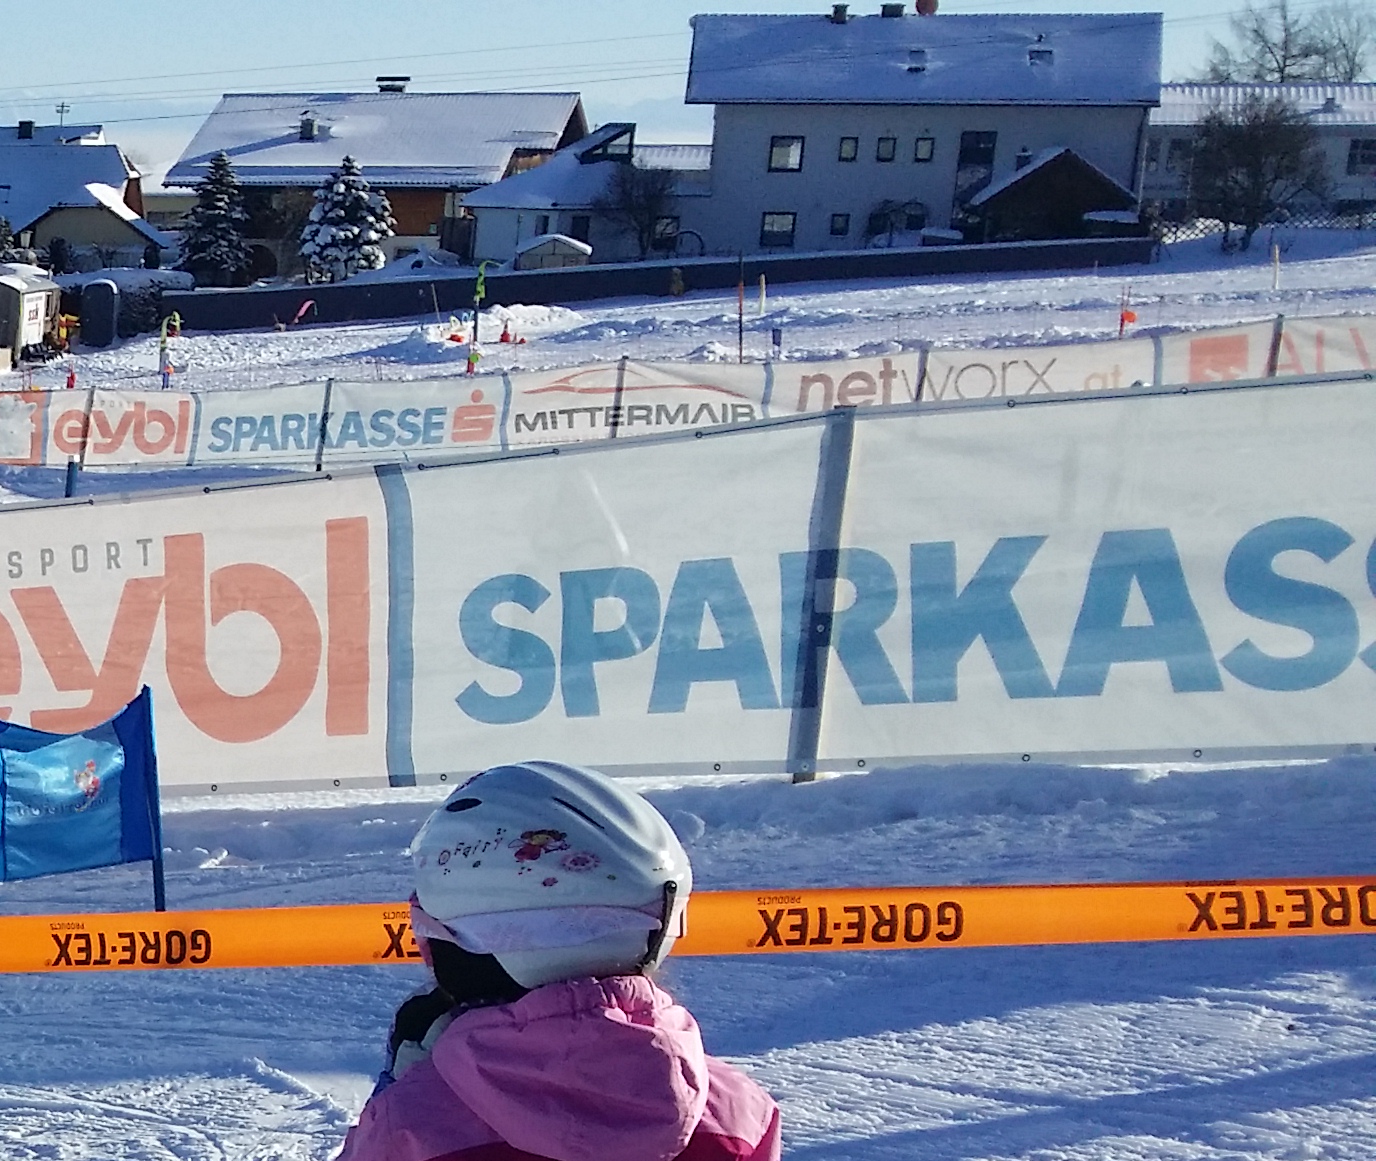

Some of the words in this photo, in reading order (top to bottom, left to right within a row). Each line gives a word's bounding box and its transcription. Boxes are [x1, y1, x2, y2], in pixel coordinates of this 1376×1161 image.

[53, 400, 191, 455] eybl
[208, 406, 447, 453] SPARKASSE
[514, 403, 756, 433] MITTERMAIR
[7, 538, 153, 579] SPORT
[454, 516, 1376, 725] SPARKAS
[757, 895, 801, 905] PRODUCTS
[1185, 885, 1376, 932] ORE-TEX
[49, 922, 86, 930] PRODUCTS
[756, 901, 965, 947] GORE-TEX
[52, 929, 213, 967] GORE-TEX
